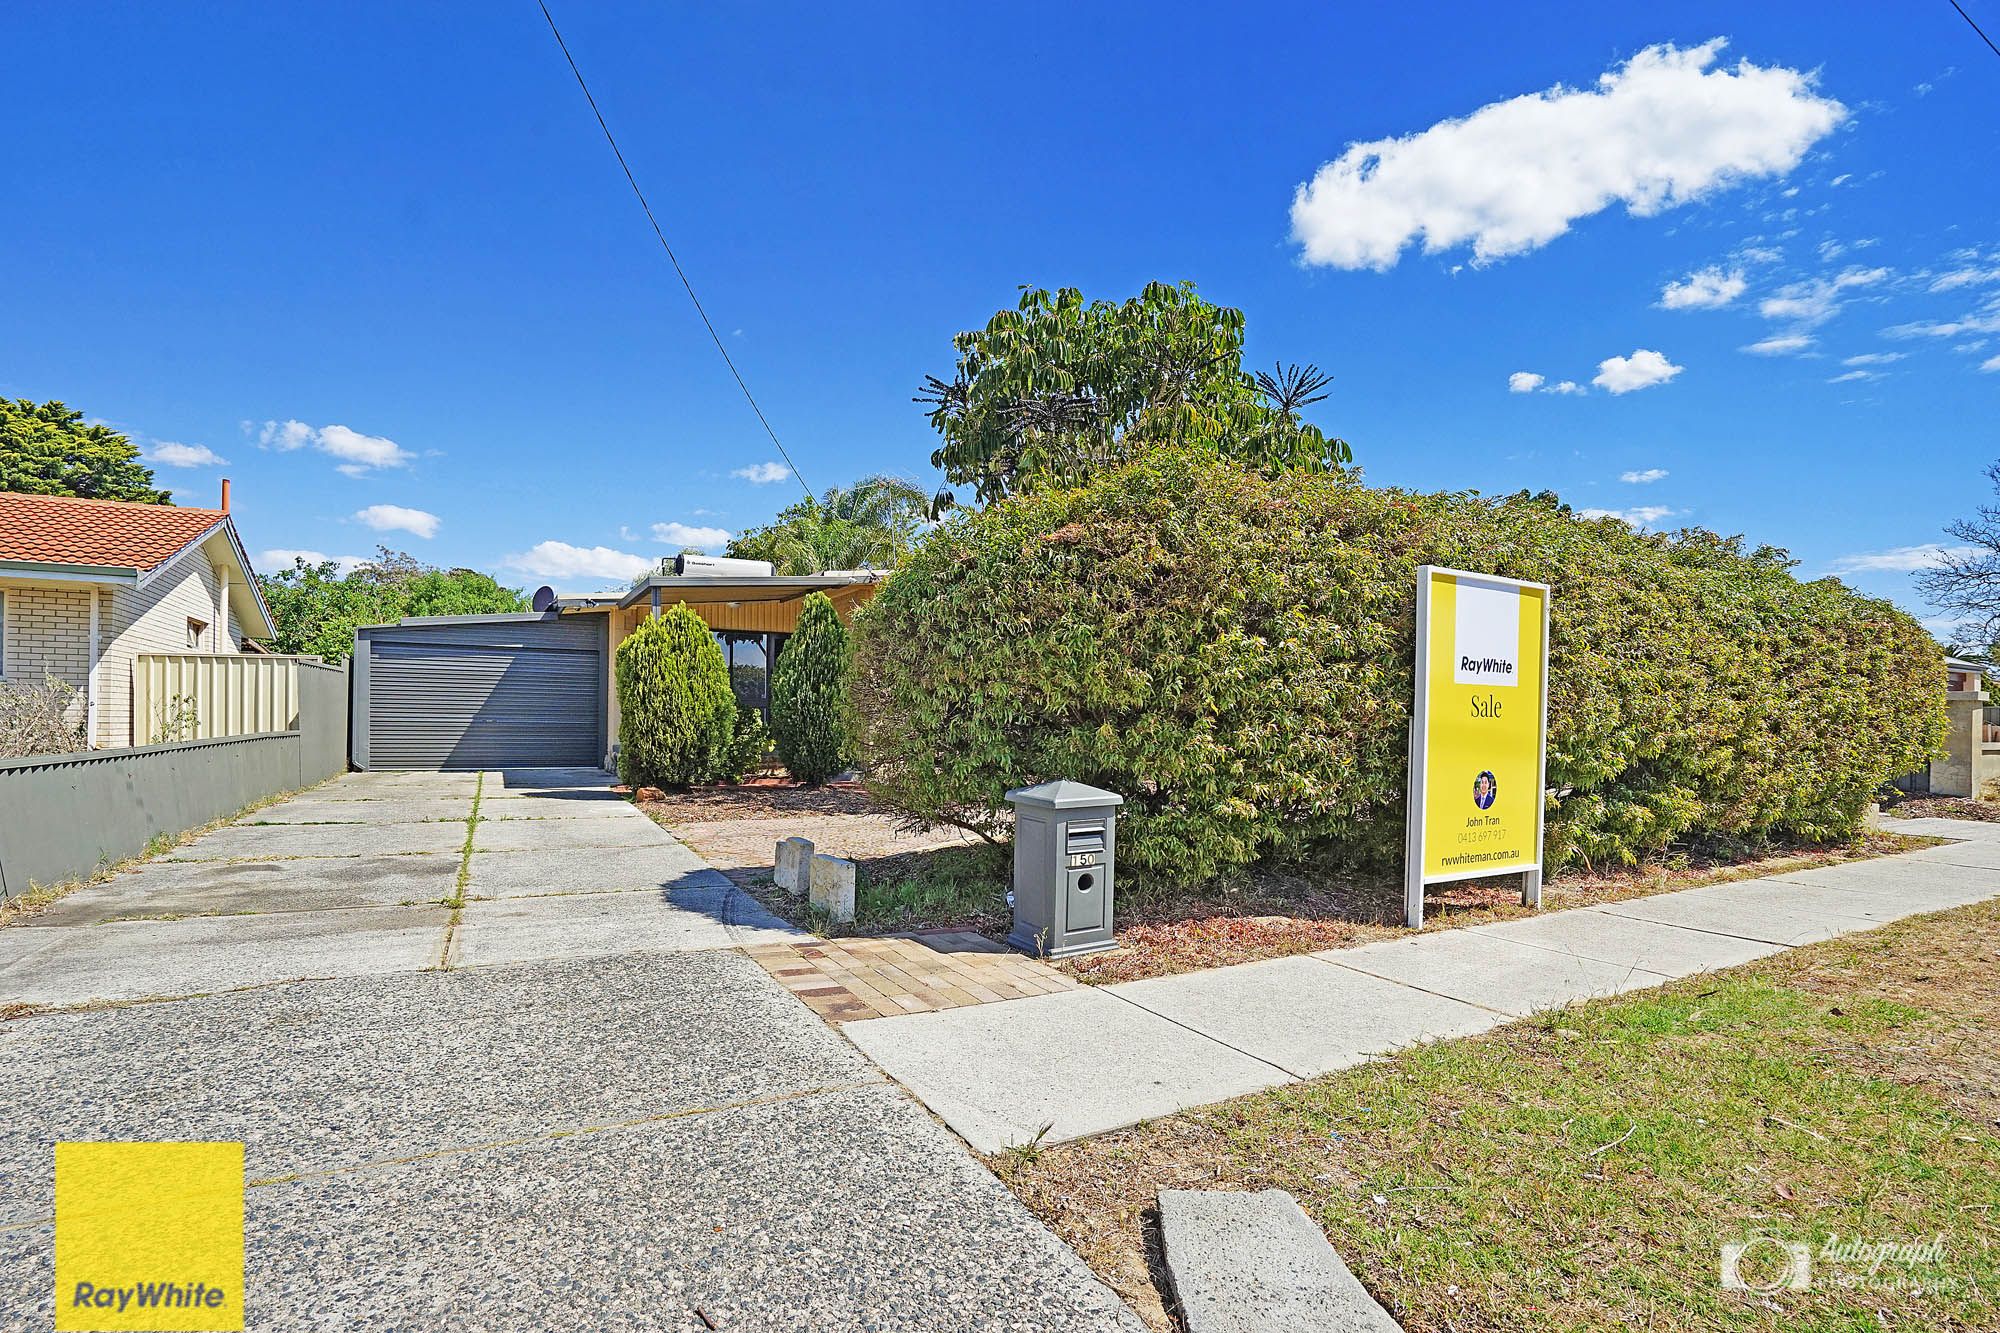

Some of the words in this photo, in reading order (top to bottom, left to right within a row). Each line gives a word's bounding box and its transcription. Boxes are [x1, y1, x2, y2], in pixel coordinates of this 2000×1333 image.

[1461, 656, 1513, 675] RayWhite
[1471, 694, 1502, 718] Sale
[1466, 817, 1483, 828] John
[1485, 815, 1500, 826] Tran
[1457, 832, 1477, 844] 0413
[1478, 830, 1492, 842] 697
[1493, 829, 1507, 840] 917
[1072, 854, 1096, 866] 150
[1441, 849, 1520, 867] rwwhiteman.com.au
